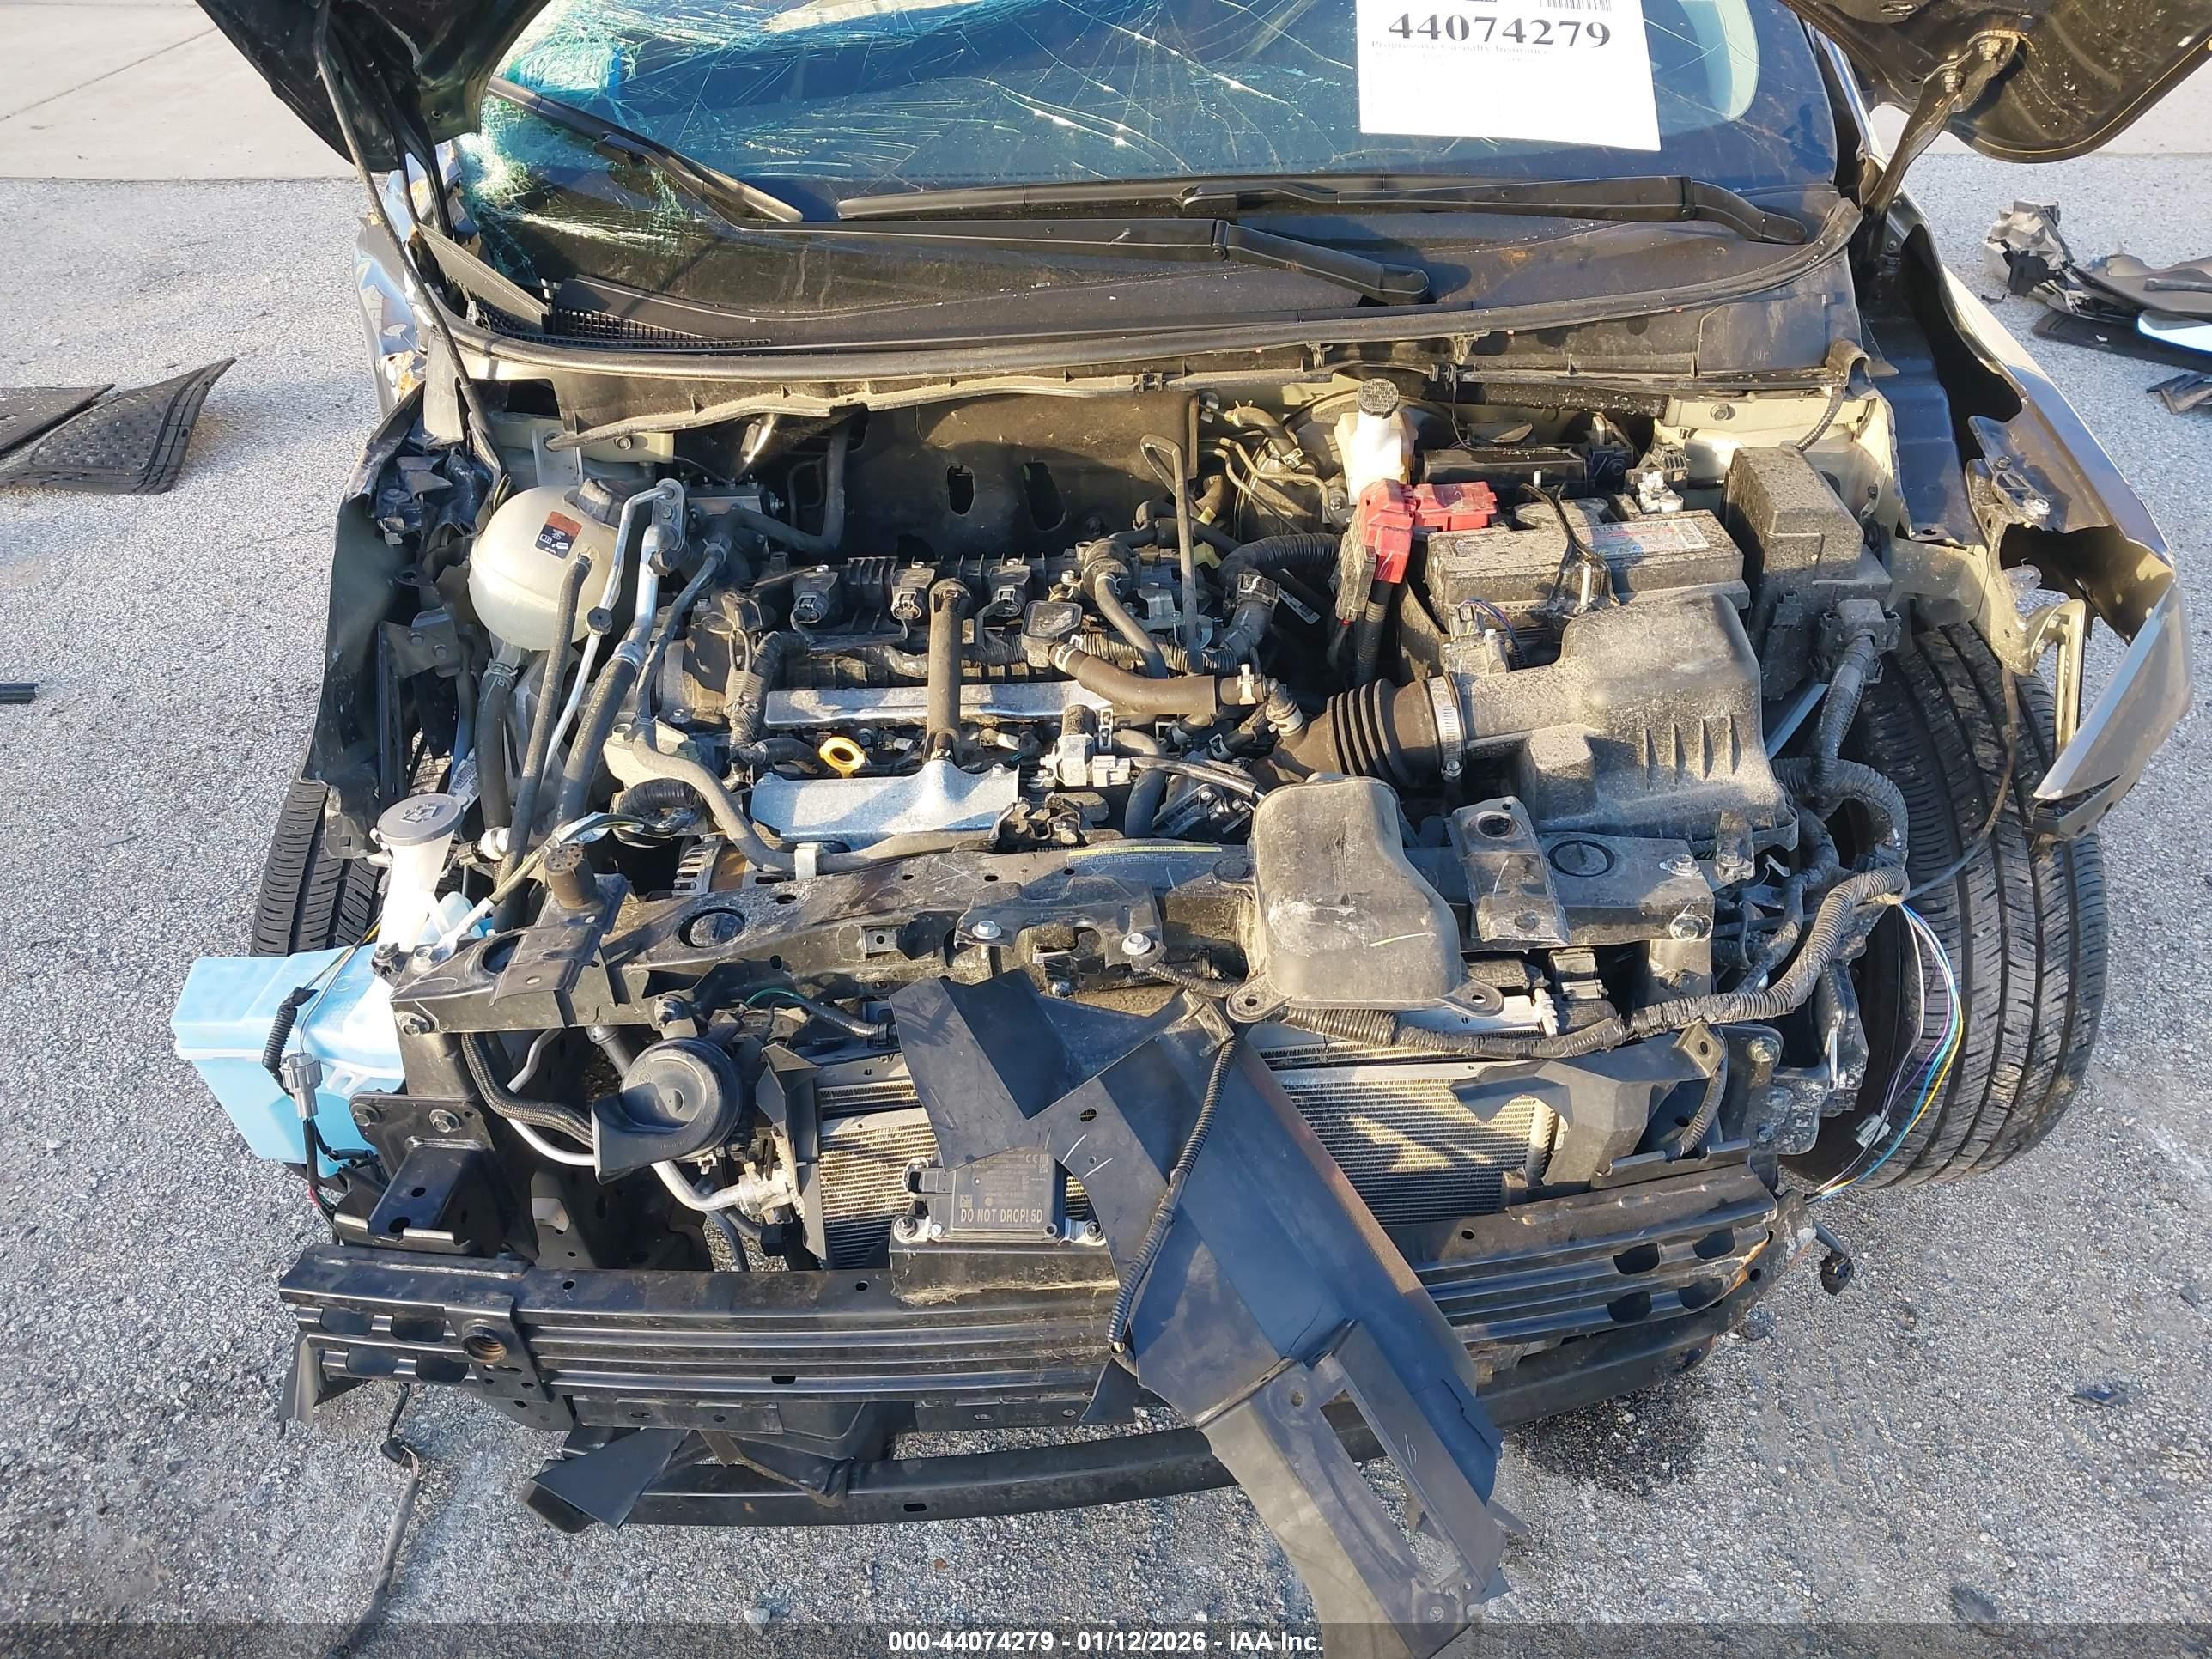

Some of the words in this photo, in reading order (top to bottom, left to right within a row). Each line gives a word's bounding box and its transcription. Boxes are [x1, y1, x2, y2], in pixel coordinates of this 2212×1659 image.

[1389, 13, 1611, 48] 44074279
[960, 1208, 975, 1223] DO
[977, 1208, 997, 1223] NOT
[1000, 1208, 1029, 1223] DROP!
